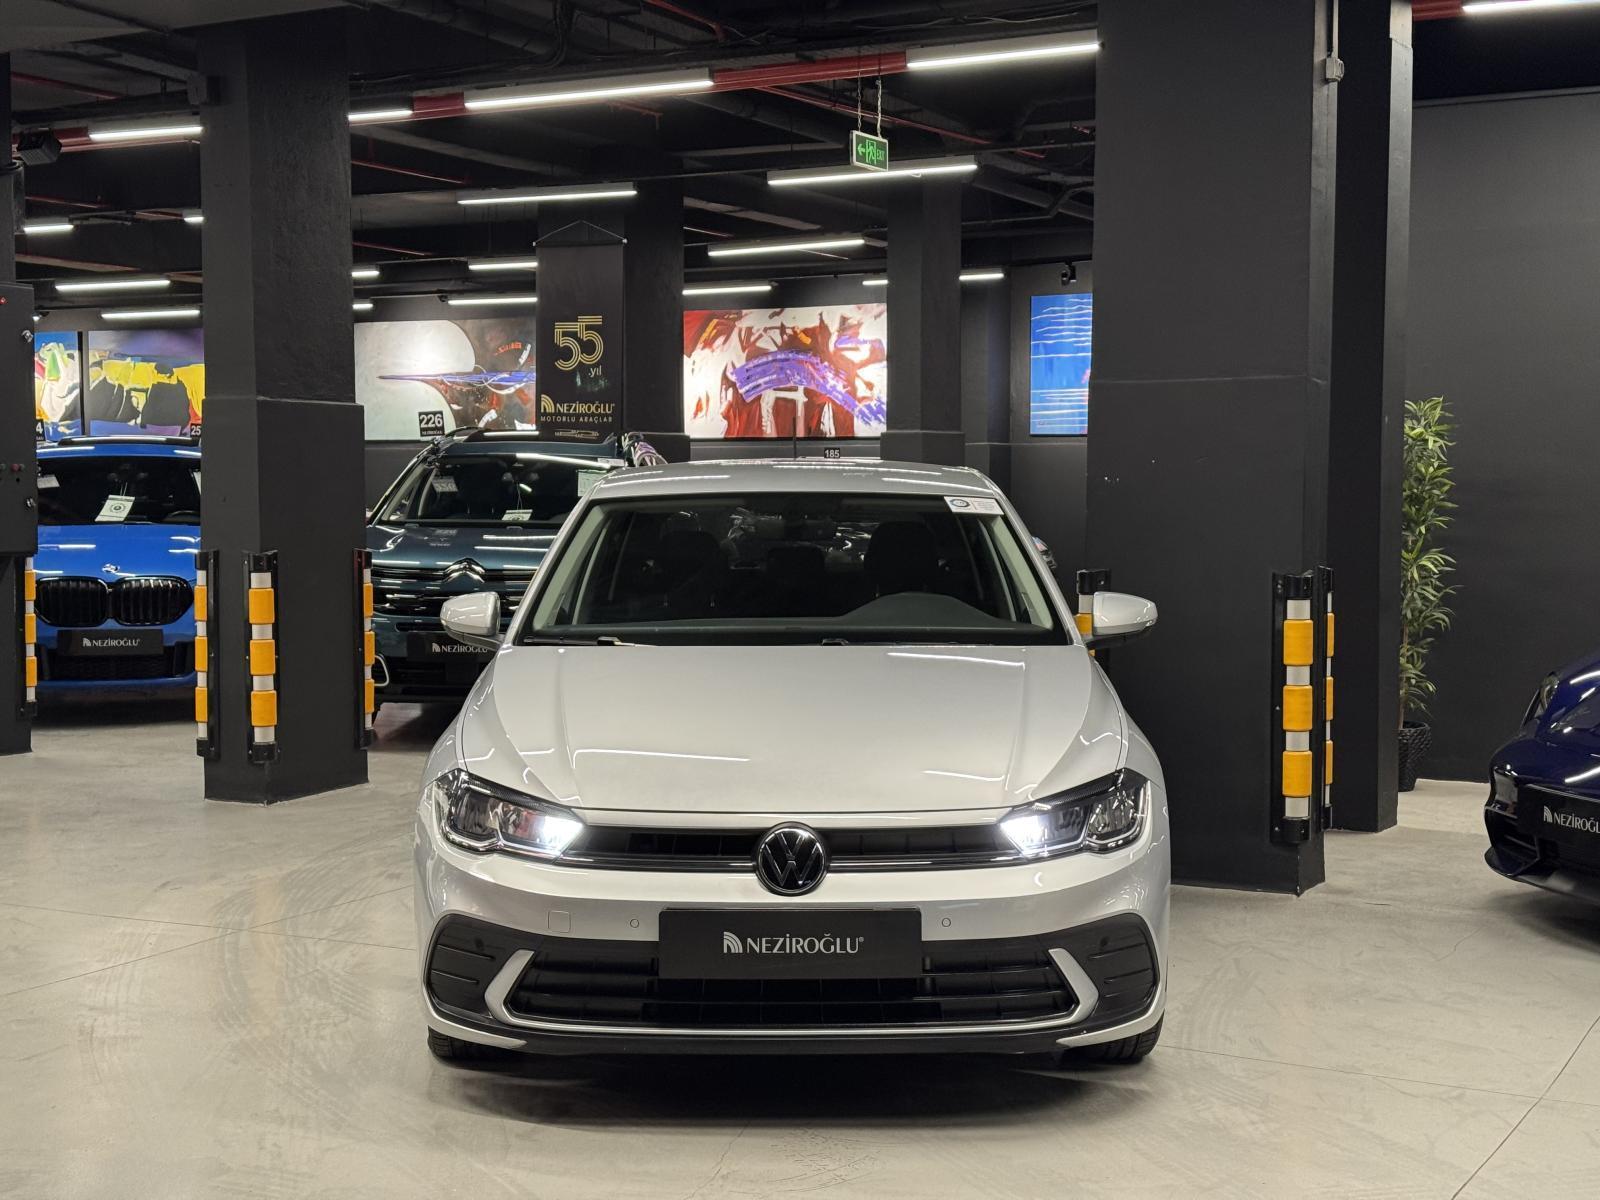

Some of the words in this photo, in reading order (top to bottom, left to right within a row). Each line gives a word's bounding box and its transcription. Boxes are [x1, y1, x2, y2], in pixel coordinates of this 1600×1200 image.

[554, 315, 604, 371] 55
[420, 413, 443, 428] 226
[191, 425, 202, 436] 25
[824, 449, 840, 458] 185
[1553, 811, 1600, 834] NEZİROĞL
